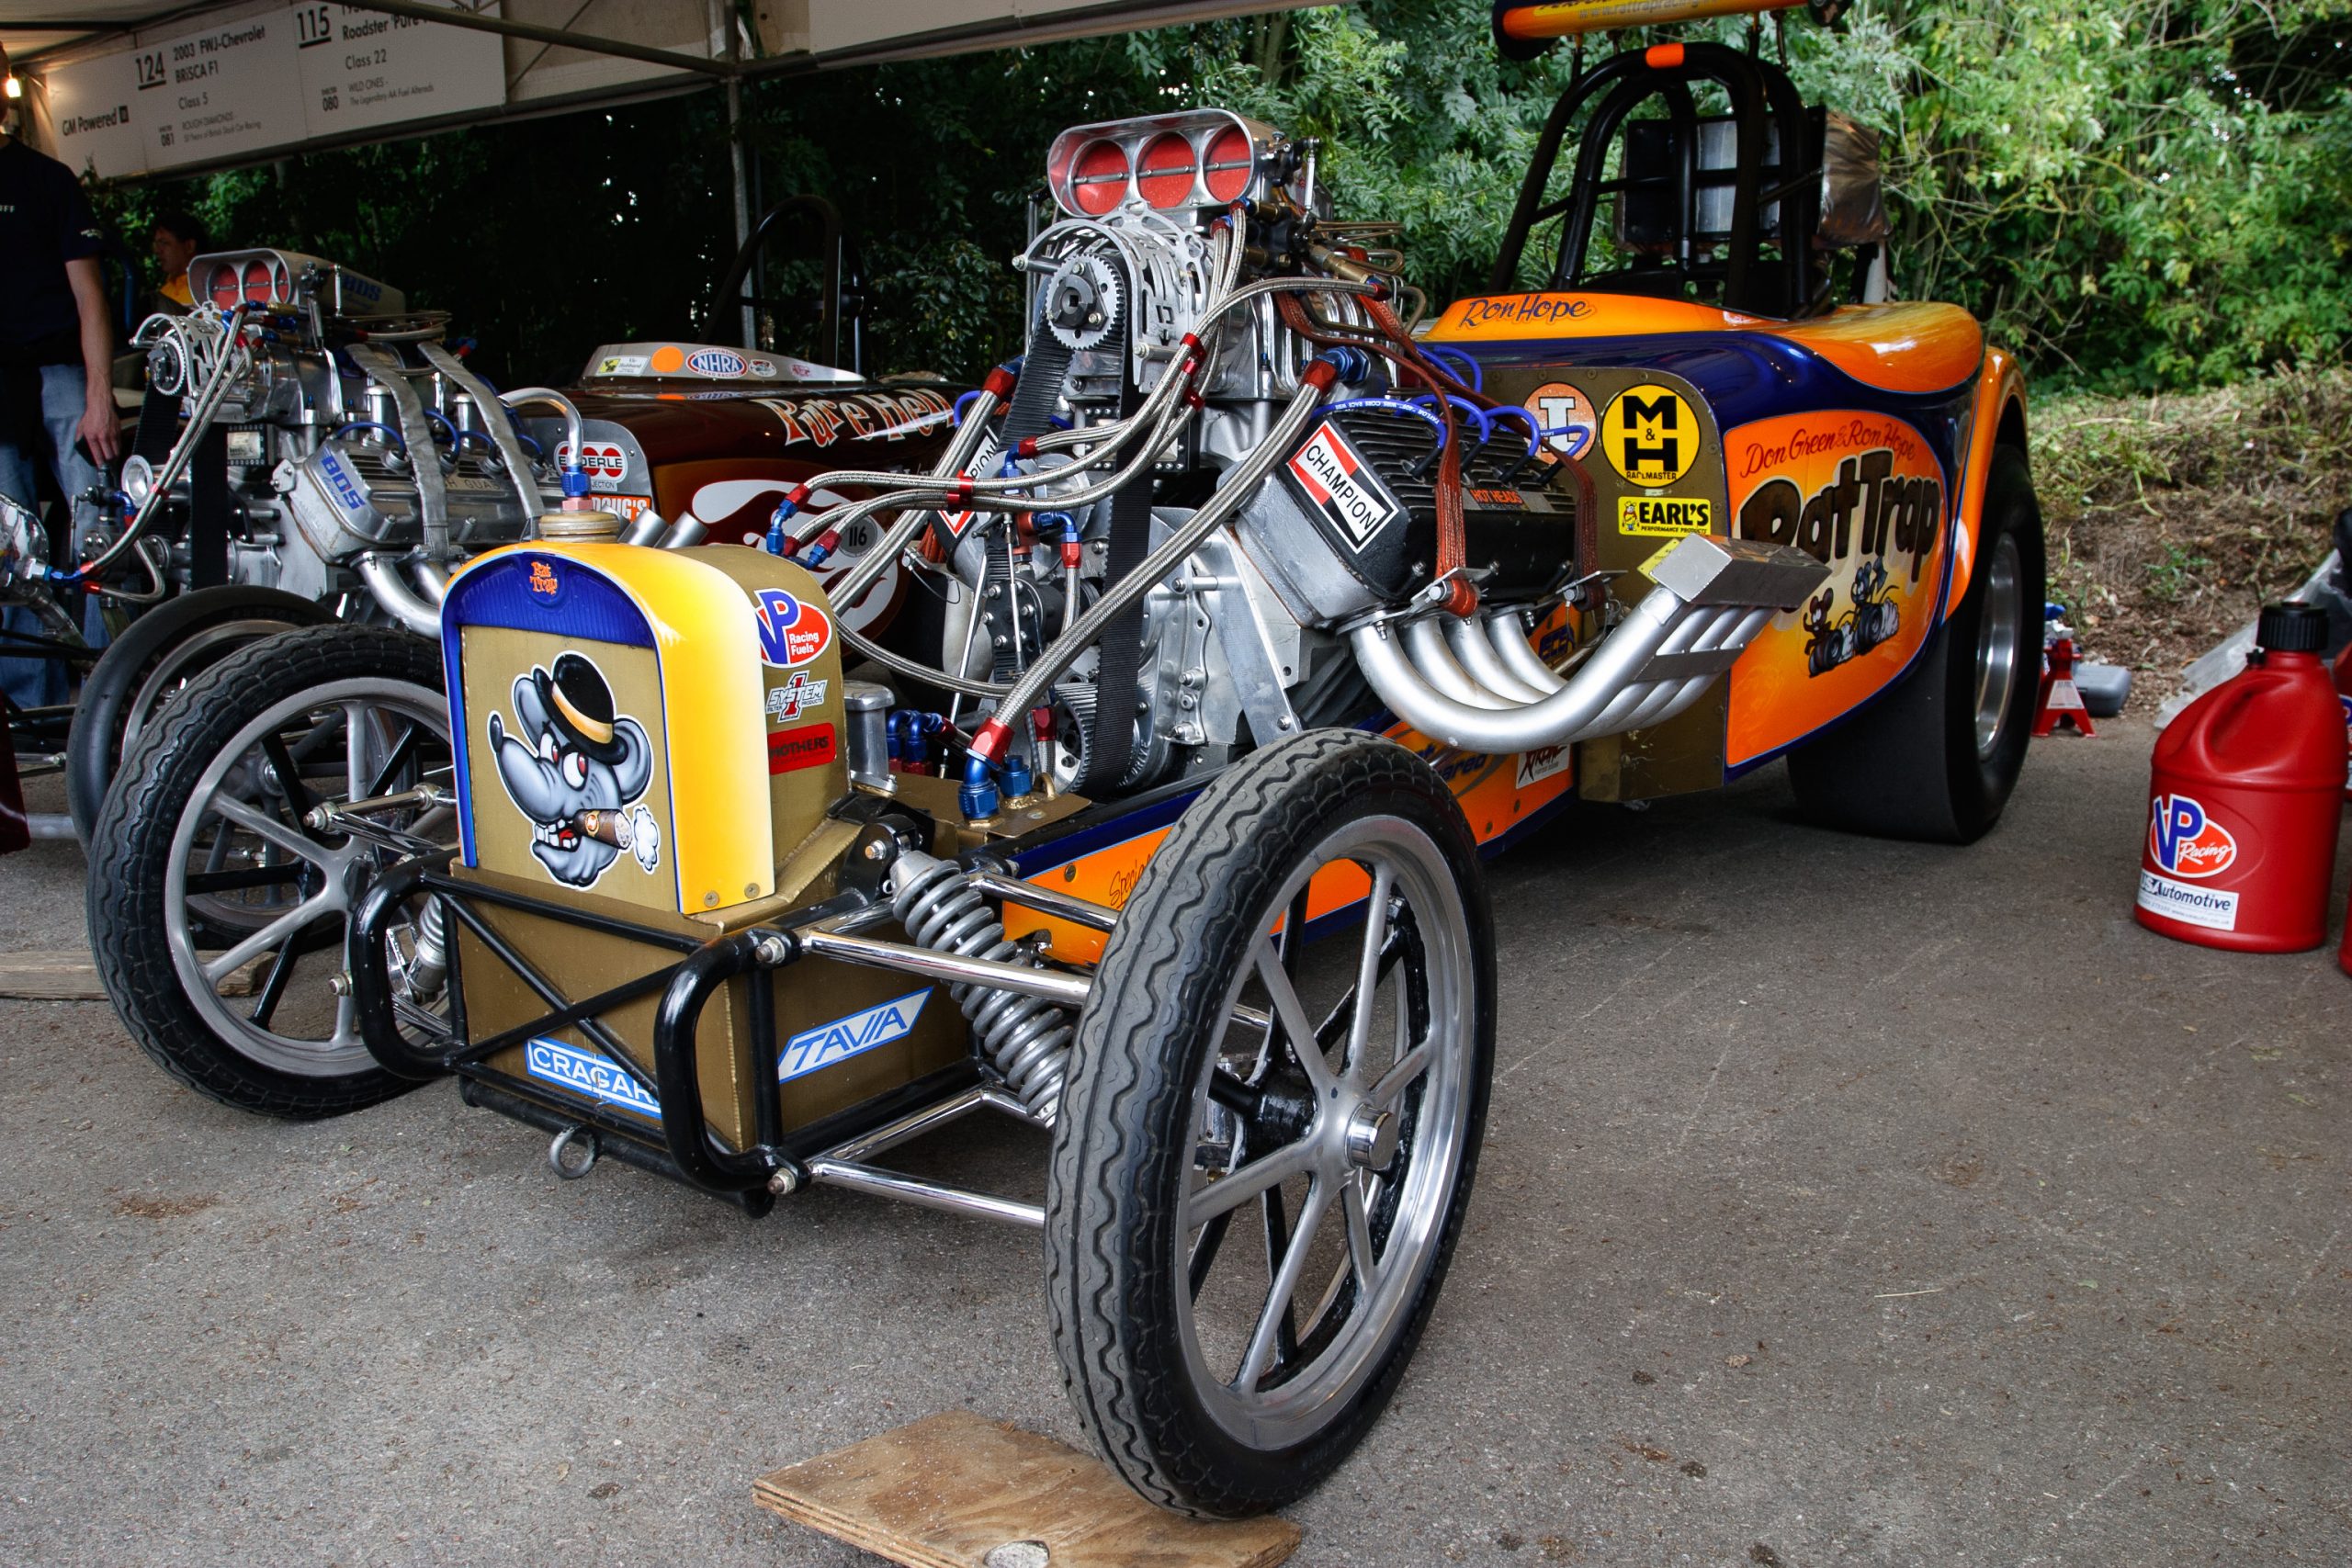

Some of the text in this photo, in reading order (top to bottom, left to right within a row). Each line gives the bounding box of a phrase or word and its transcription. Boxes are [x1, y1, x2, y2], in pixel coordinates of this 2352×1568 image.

[297, 6, 330, 40] 115
[342, 19, 389, 40] Roadster
[173, 25, 266, 62] 2003 FWJ-Chevrolet
[136, 51, 165, 84] 124
[208, 61, 220, 75] F1
[345, 49, 387, 70] Class 22
[177, 92, 209, 110] Class 5
[322, 96, 339, 112] 080
[62, 107, 118, 137] GM Powered
[1459, 294, 1592, 327] Ron Hope
[697, 354, 741, 373] NHRA
[750, 389, 955, 447] Pure Hell
[1623, 396, 1678, 429] M
[1645, 428, 1656, 441] &
[1624, 437, 1679, 471] H
[1740, 443, 1788, 479] Don
[1790, 428, 1838, 461] Green
[1844, 420, 1883, 447] Ron
[1883, 423, 1917, 462] Hope
[559, 456, 624, 469] EDERLE
[322, 453, 367, 510] BDS
[1306, 444, 1377, 531] CHAMPION
[1470, 489, 1523, 504] HOT HEADS
[1638, 502, 1709, 526] EARL'S
[1740, 449, 1941, 584] Rat Trap
[848, 527, 868, 547] 116
[1640, 525, 1679, 534] PERFORMANCE
[531, 560, 551, 578] Rat
[529, 575, 558, 595] Trap
[788, 630, 820, 645] Racing
[790, 643, 815, 657] Fuels
[767, 682, 826, 707] SYSTEM
[767, 697, 824, 713] FILTER PRODUCTS
[2154, 797, 2204, 872] VP
[2178, 841, 2234, 865] Racing
